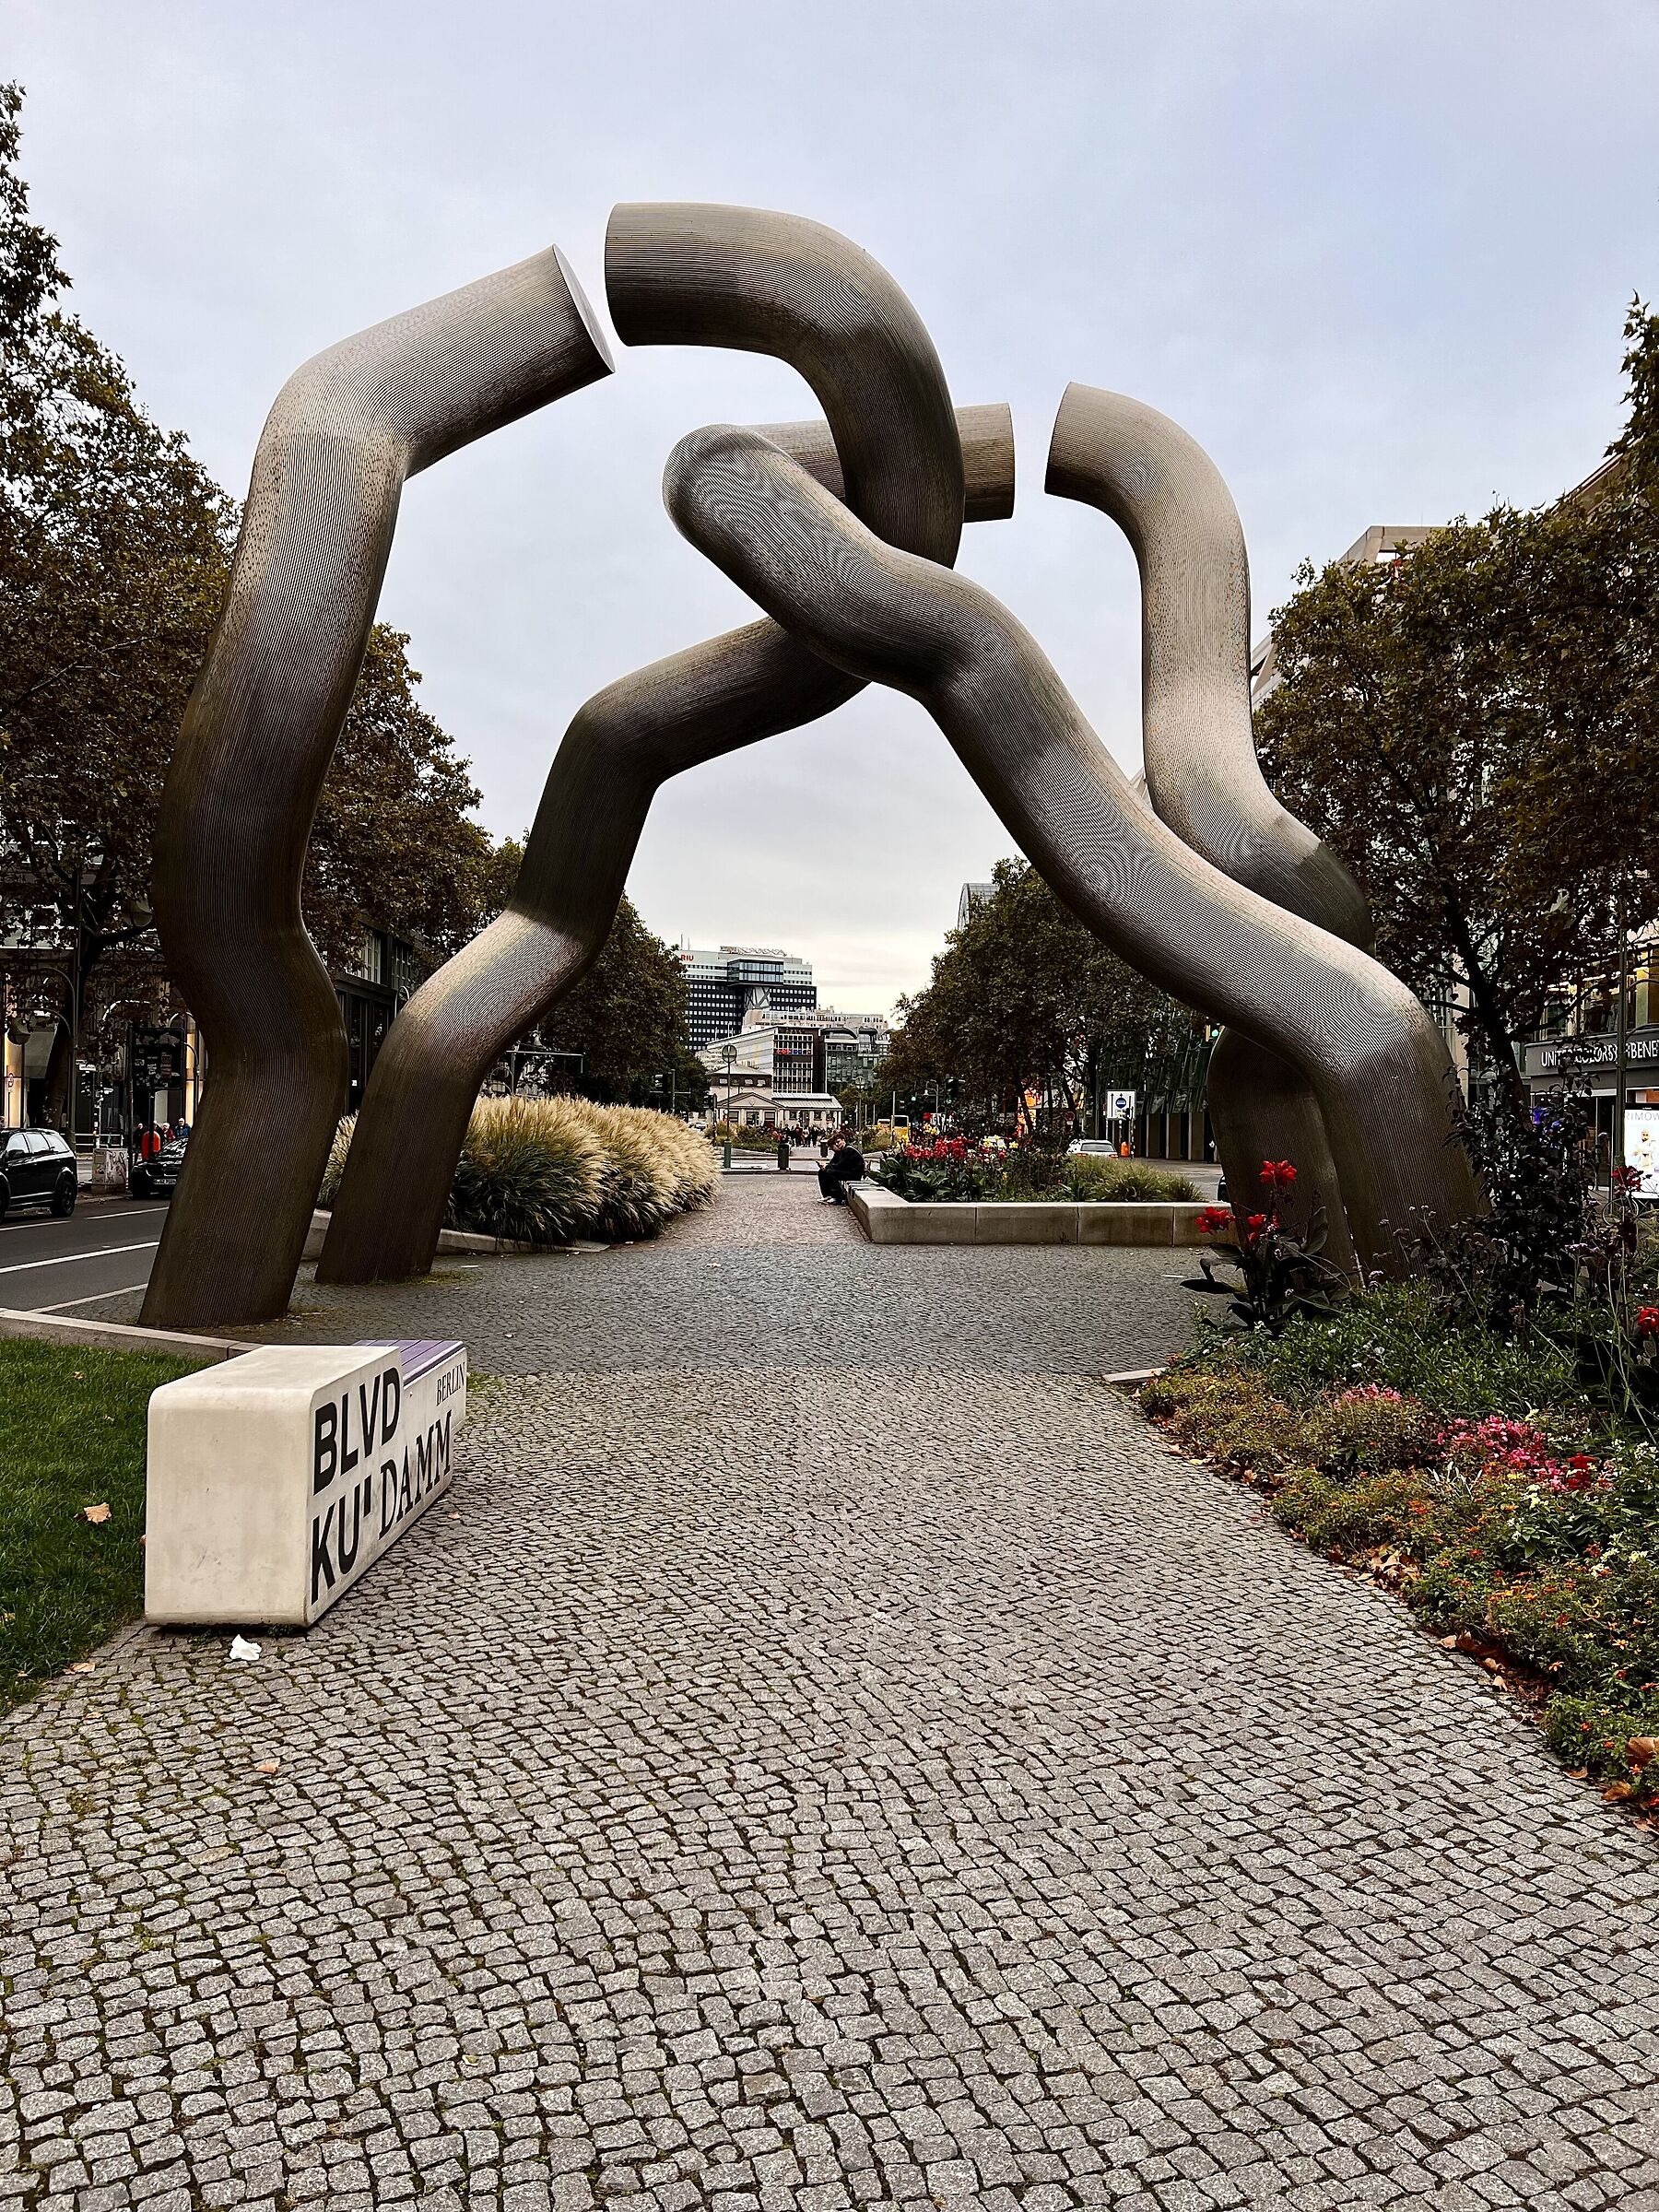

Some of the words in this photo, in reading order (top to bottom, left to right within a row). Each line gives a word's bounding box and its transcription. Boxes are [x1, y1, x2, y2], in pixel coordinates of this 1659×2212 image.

[1541, 1048, 1574, 1067] UNIT
[1629, 1040, 1659, 1059] BENE
[436, 1361, 465, 1406] BERLIN
[313, 1367, 401, 1496] BLVD
